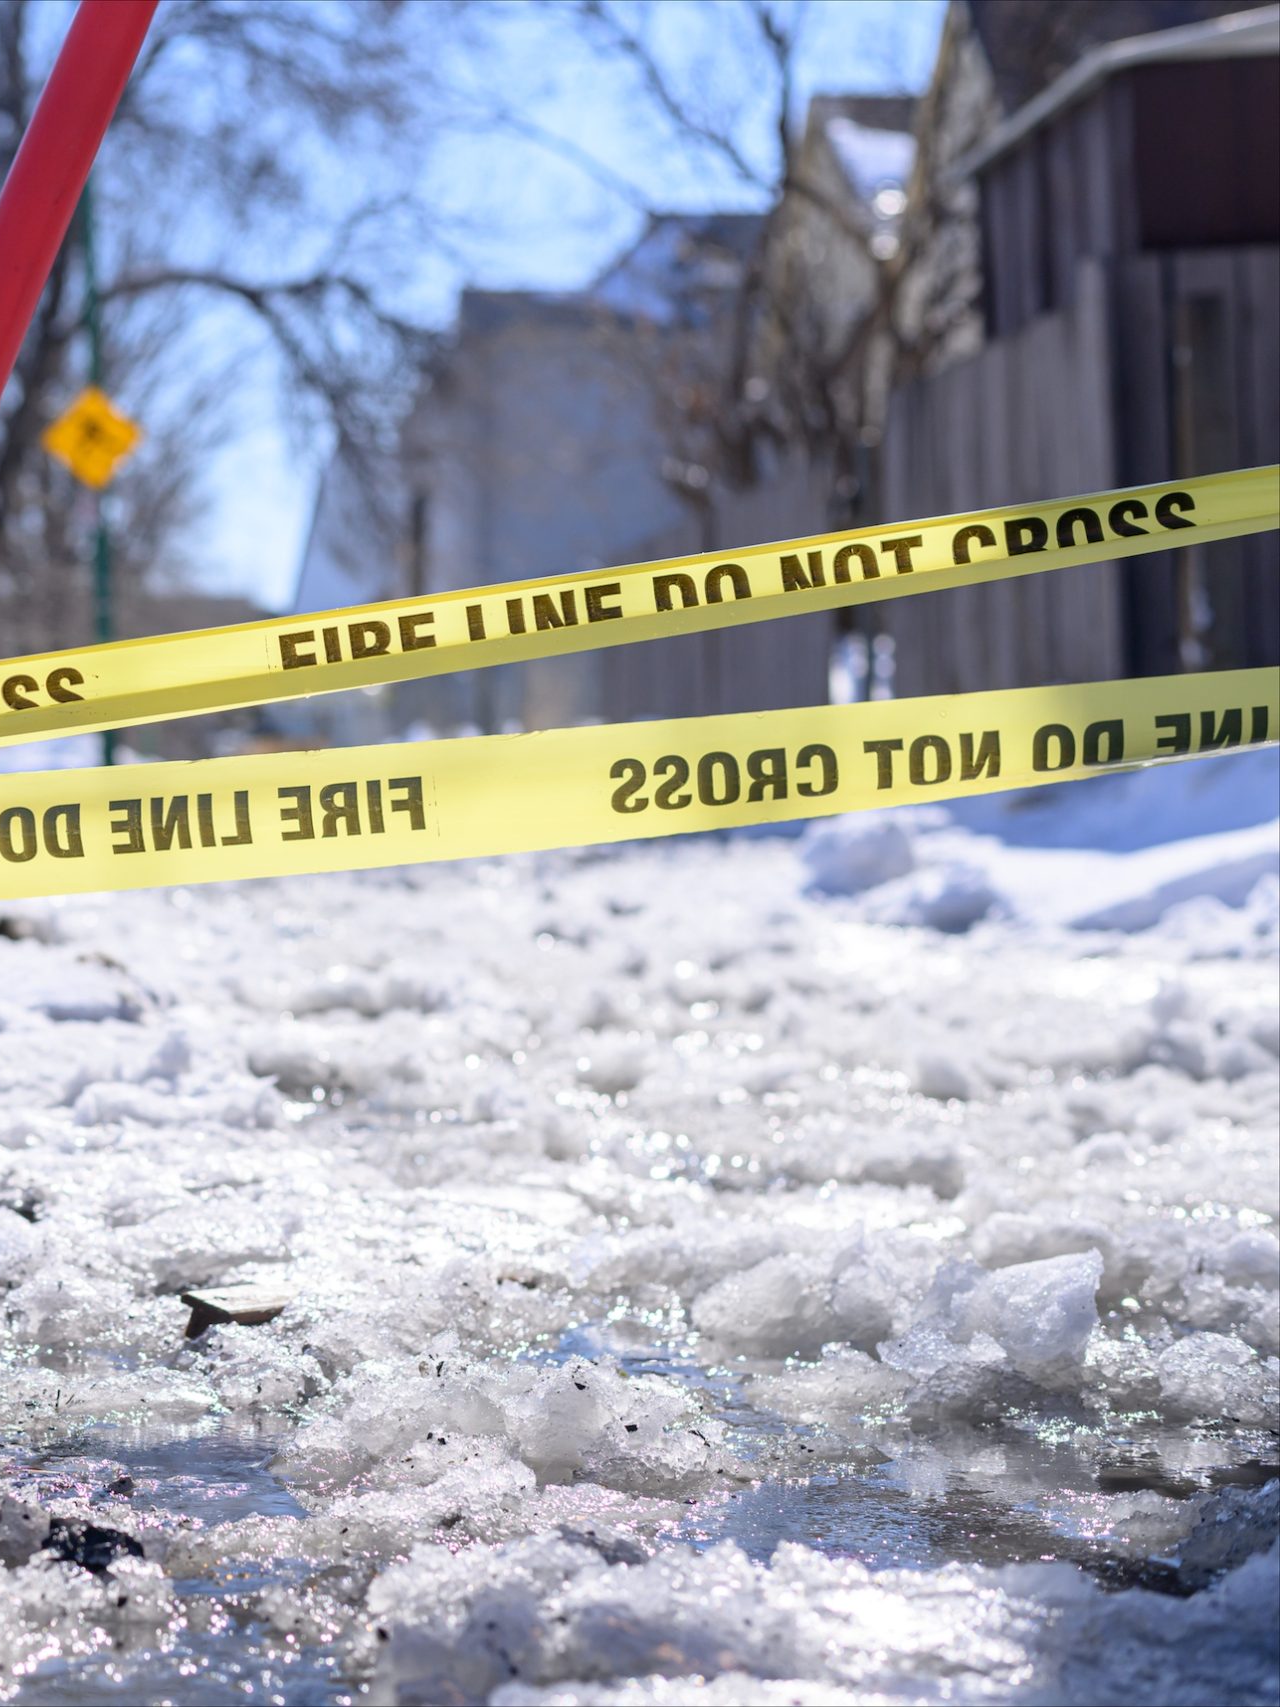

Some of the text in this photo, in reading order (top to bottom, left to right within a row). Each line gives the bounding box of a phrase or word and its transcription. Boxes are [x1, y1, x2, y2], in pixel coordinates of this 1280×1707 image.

[278, 491, 1198, 670] FIRE LINE DO NOT CROSS
